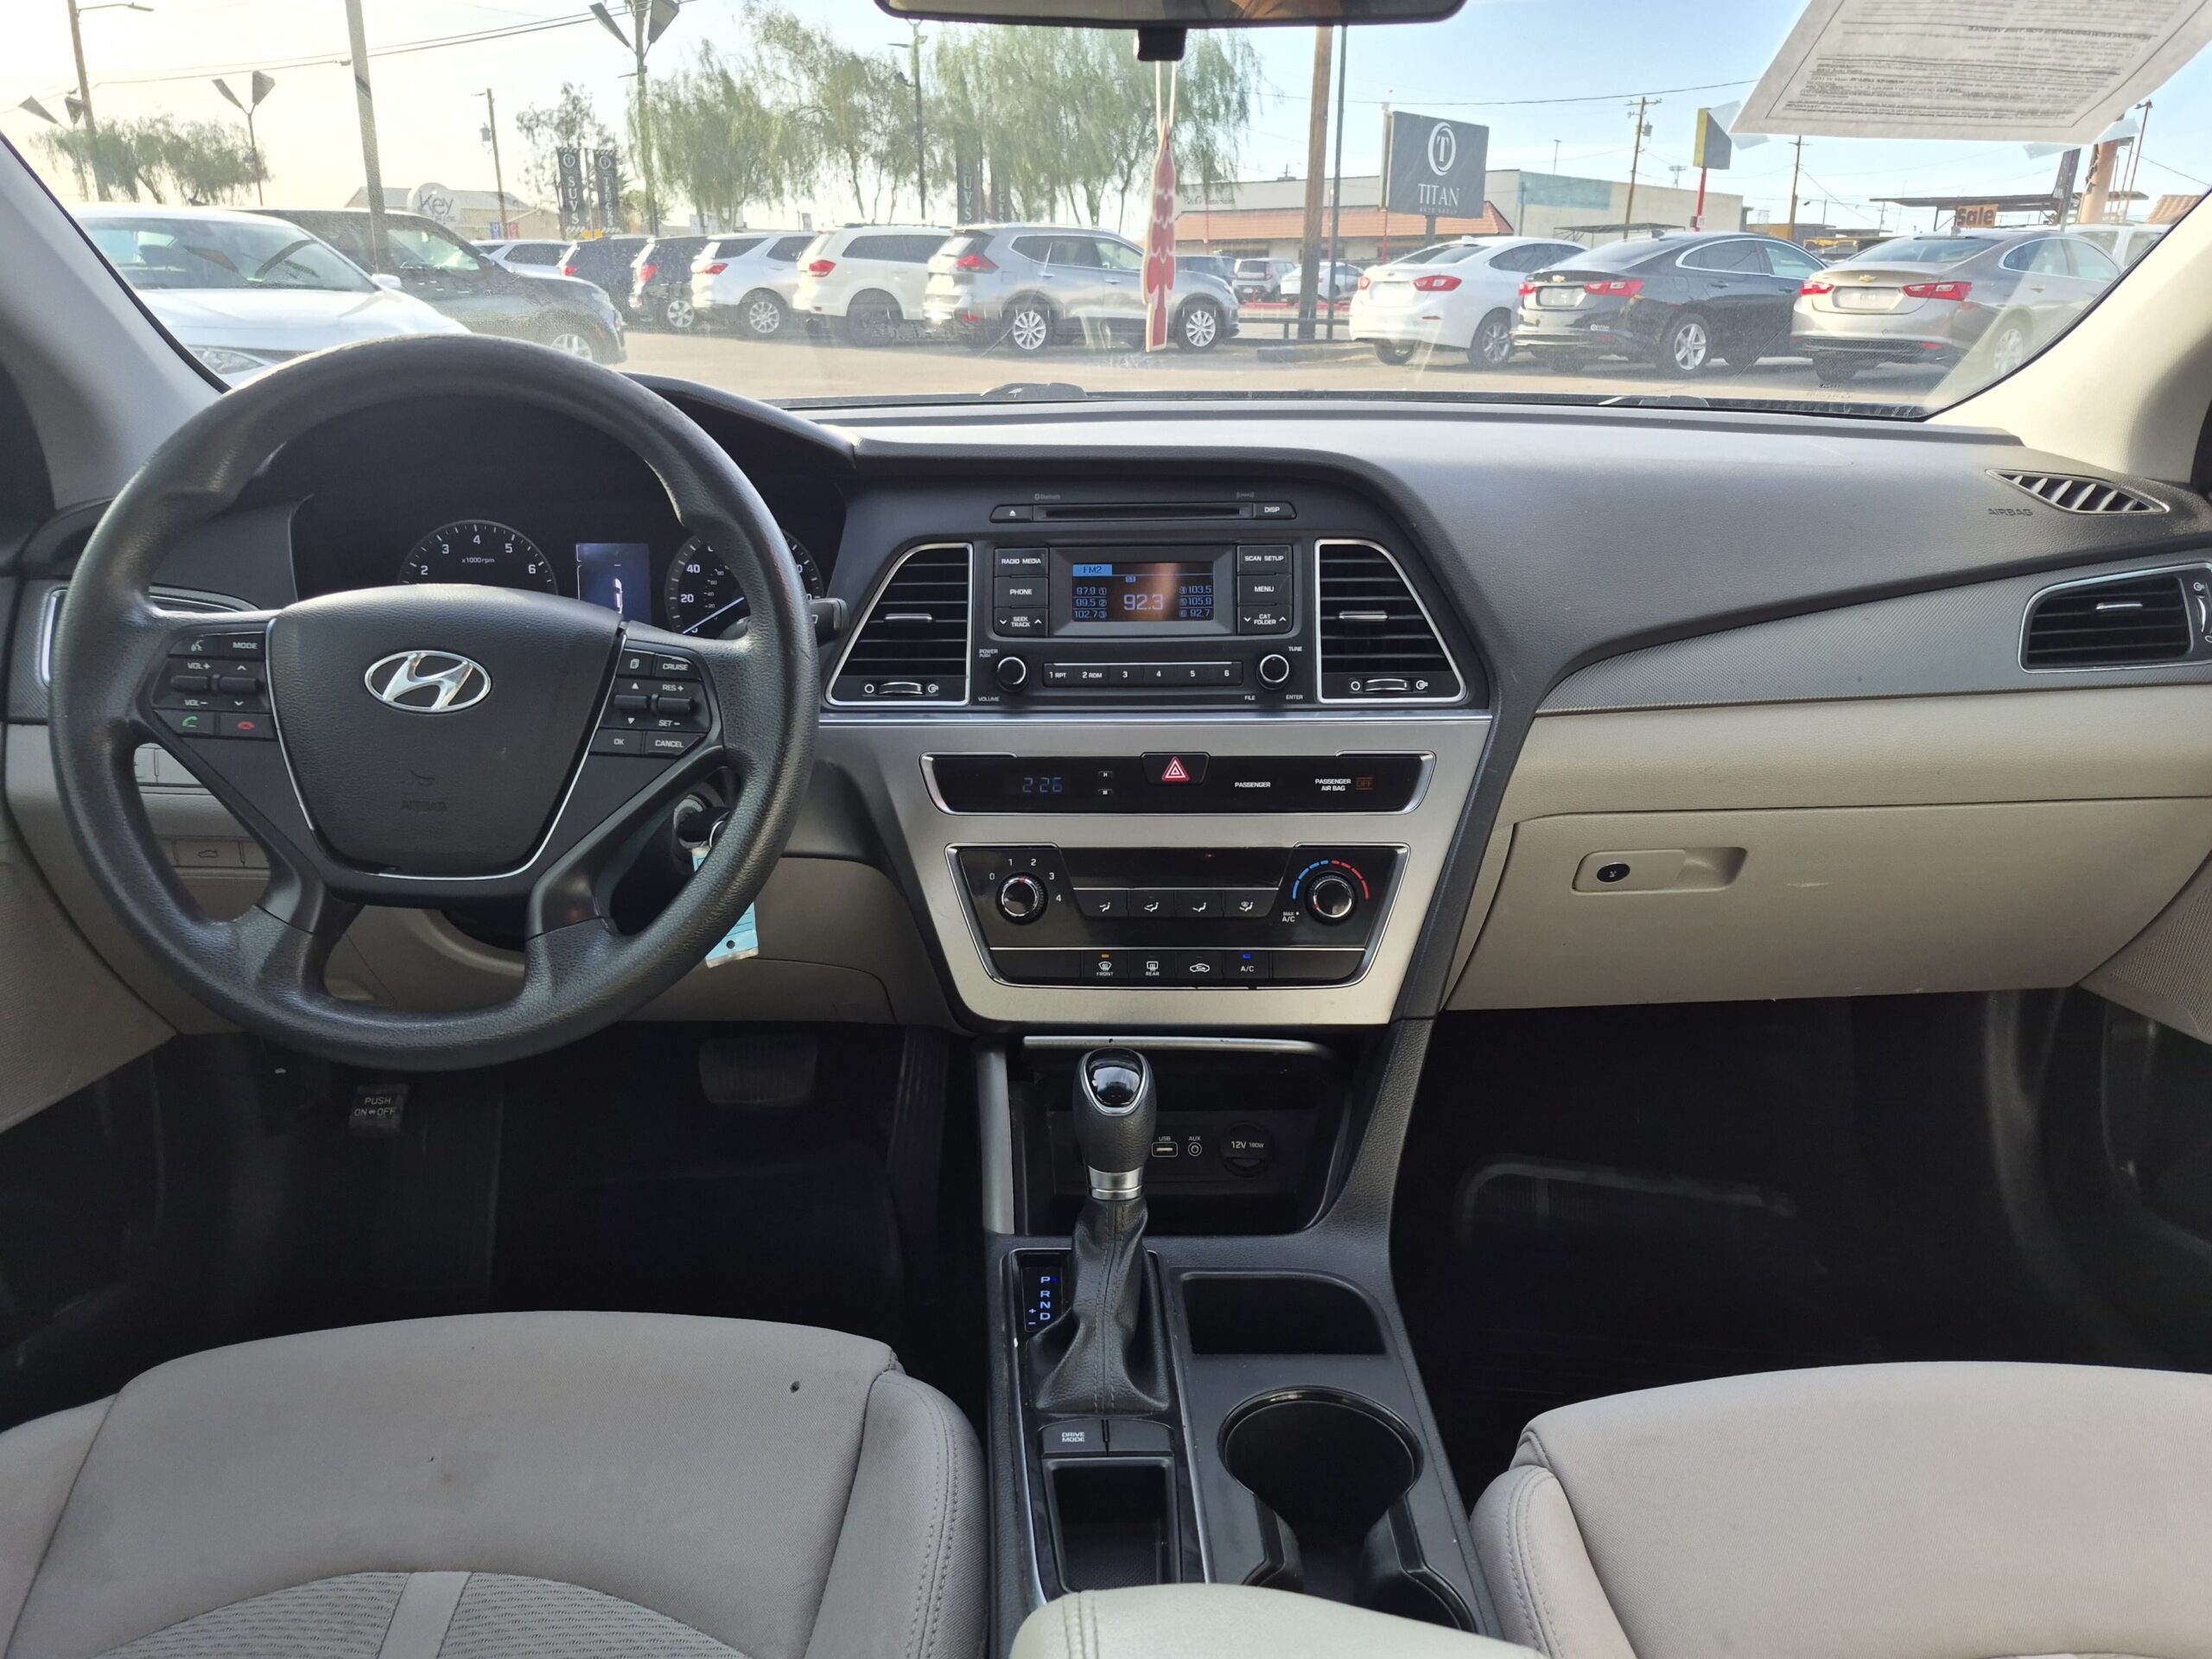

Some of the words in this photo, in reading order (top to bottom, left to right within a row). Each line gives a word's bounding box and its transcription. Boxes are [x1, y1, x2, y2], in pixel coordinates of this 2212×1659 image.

[1418, 183, 1460, 207] TITAN
[568, 175, 580, 225] SUVS
[1956, 207, 1995, 226] Sale
[1988, 507, 2033, 517] AIRBAG
[472, 535, 481, 546] 4
[441, 543, 450, 554] 3
[505, 543, 513, 554] 5
[420, 564, 429, 575] 2
[528, 563, 537, 575] 6
[686, 563, 701, 574] 40
[1188, 585, 1212, 594] 103.5
[680, 594, 694, 603] 20
[1123, 594, 1164, 611] 92.3
[1188, 596, 1212, 606] 105.9
[1075, 610, 1097, 619] 102.7
[1190, 608, 1211, 617] 92.7
[232, 641, 257, 650] MODE
[662, 663, 689, 671] CRUISE
[654, 739, 684, 748] CANCEL
[1008, 858, 1013, 867] 1
[1030, 858, 1037, 867] 2
[363, 1096, 392, 1105] PUSH
[353, 1108, 368, 1117] ON
[376, 1107, 397, 1116] OFF
[1230, 1141, 1247, 1149] 12V
[1039, 1275, 1052, 1284] P
[1039, 1301, 1052, 1310] N
